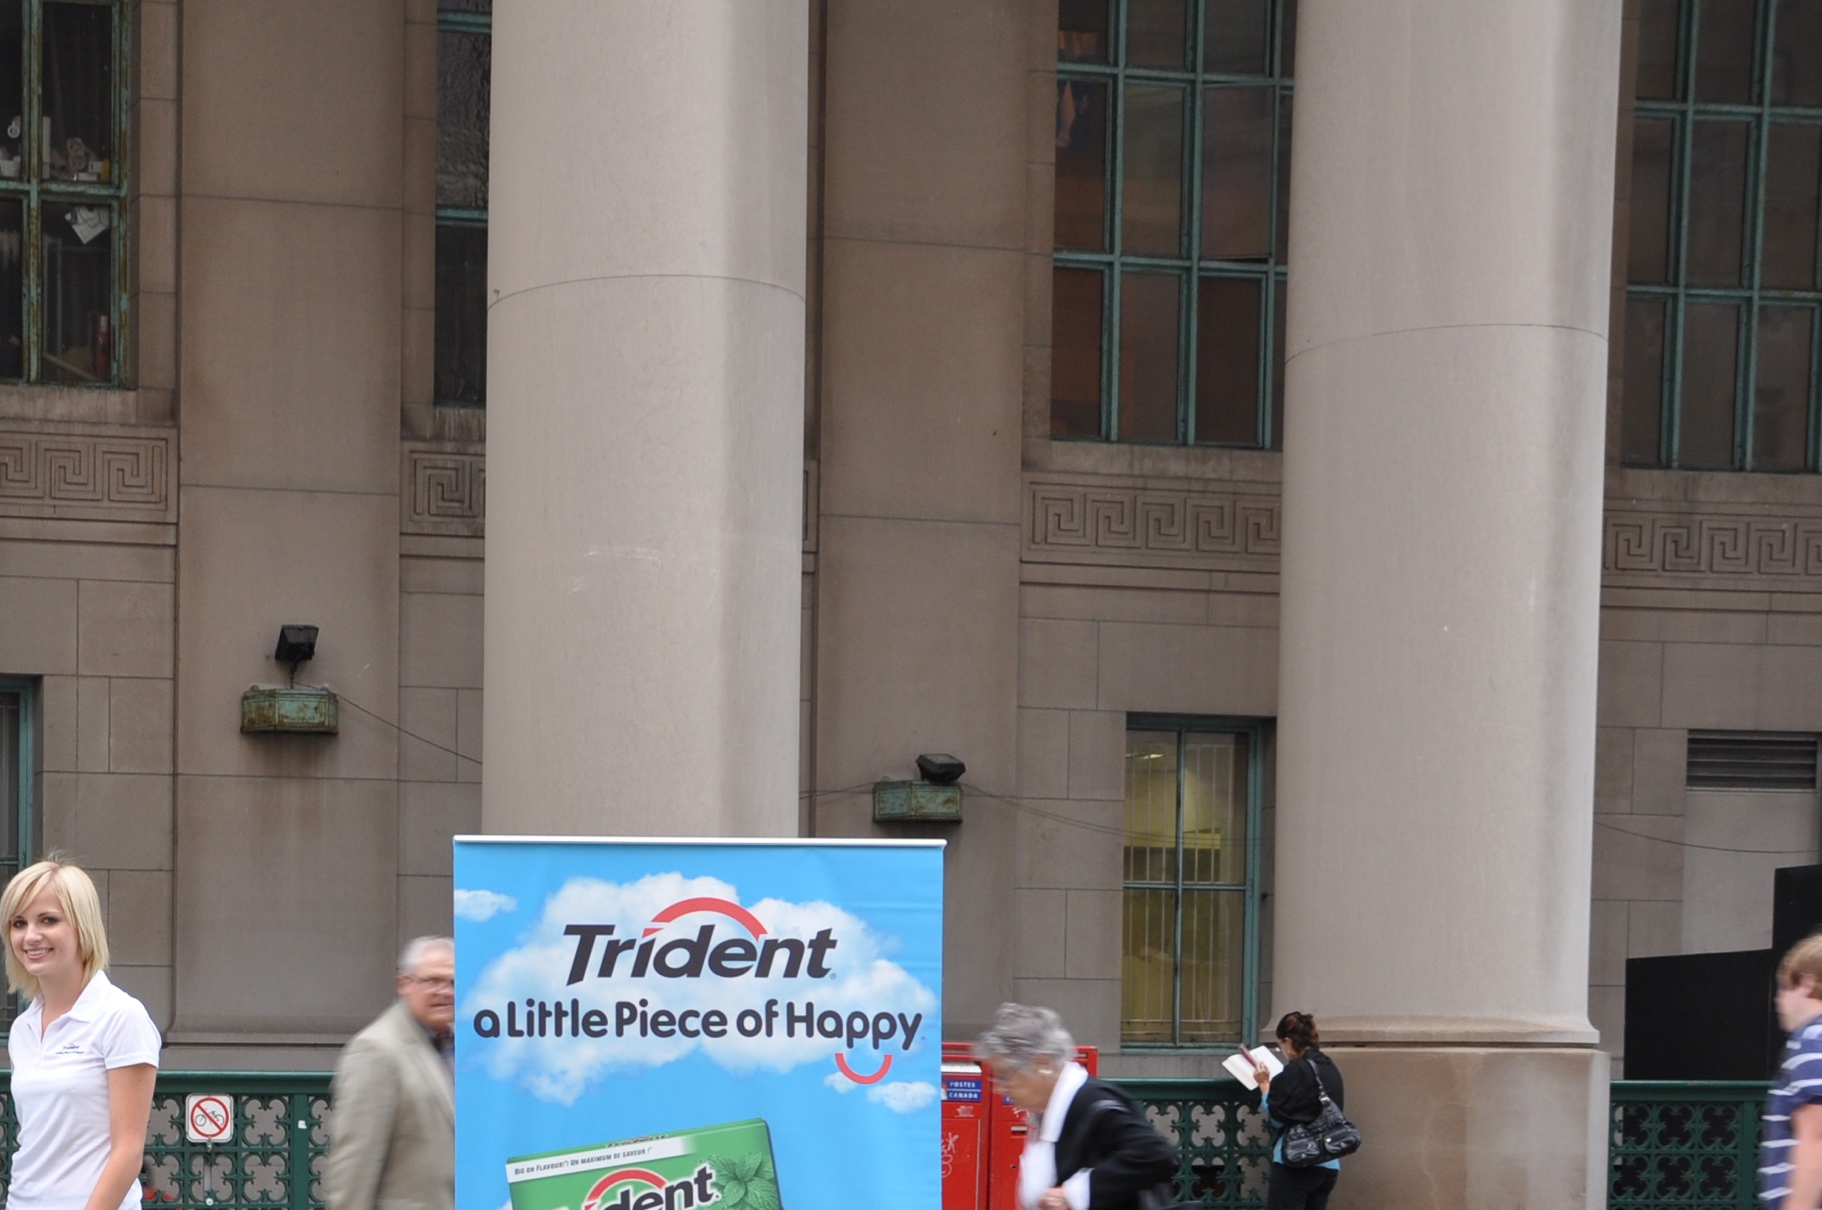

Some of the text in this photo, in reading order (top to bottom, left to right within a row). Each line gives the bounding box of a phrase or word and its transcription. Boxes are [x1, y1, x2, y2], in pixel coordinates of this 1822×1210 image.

[563, 923, 838, 987] Trident
[473, 998, 923, 1051] a Little Piece of Happy
